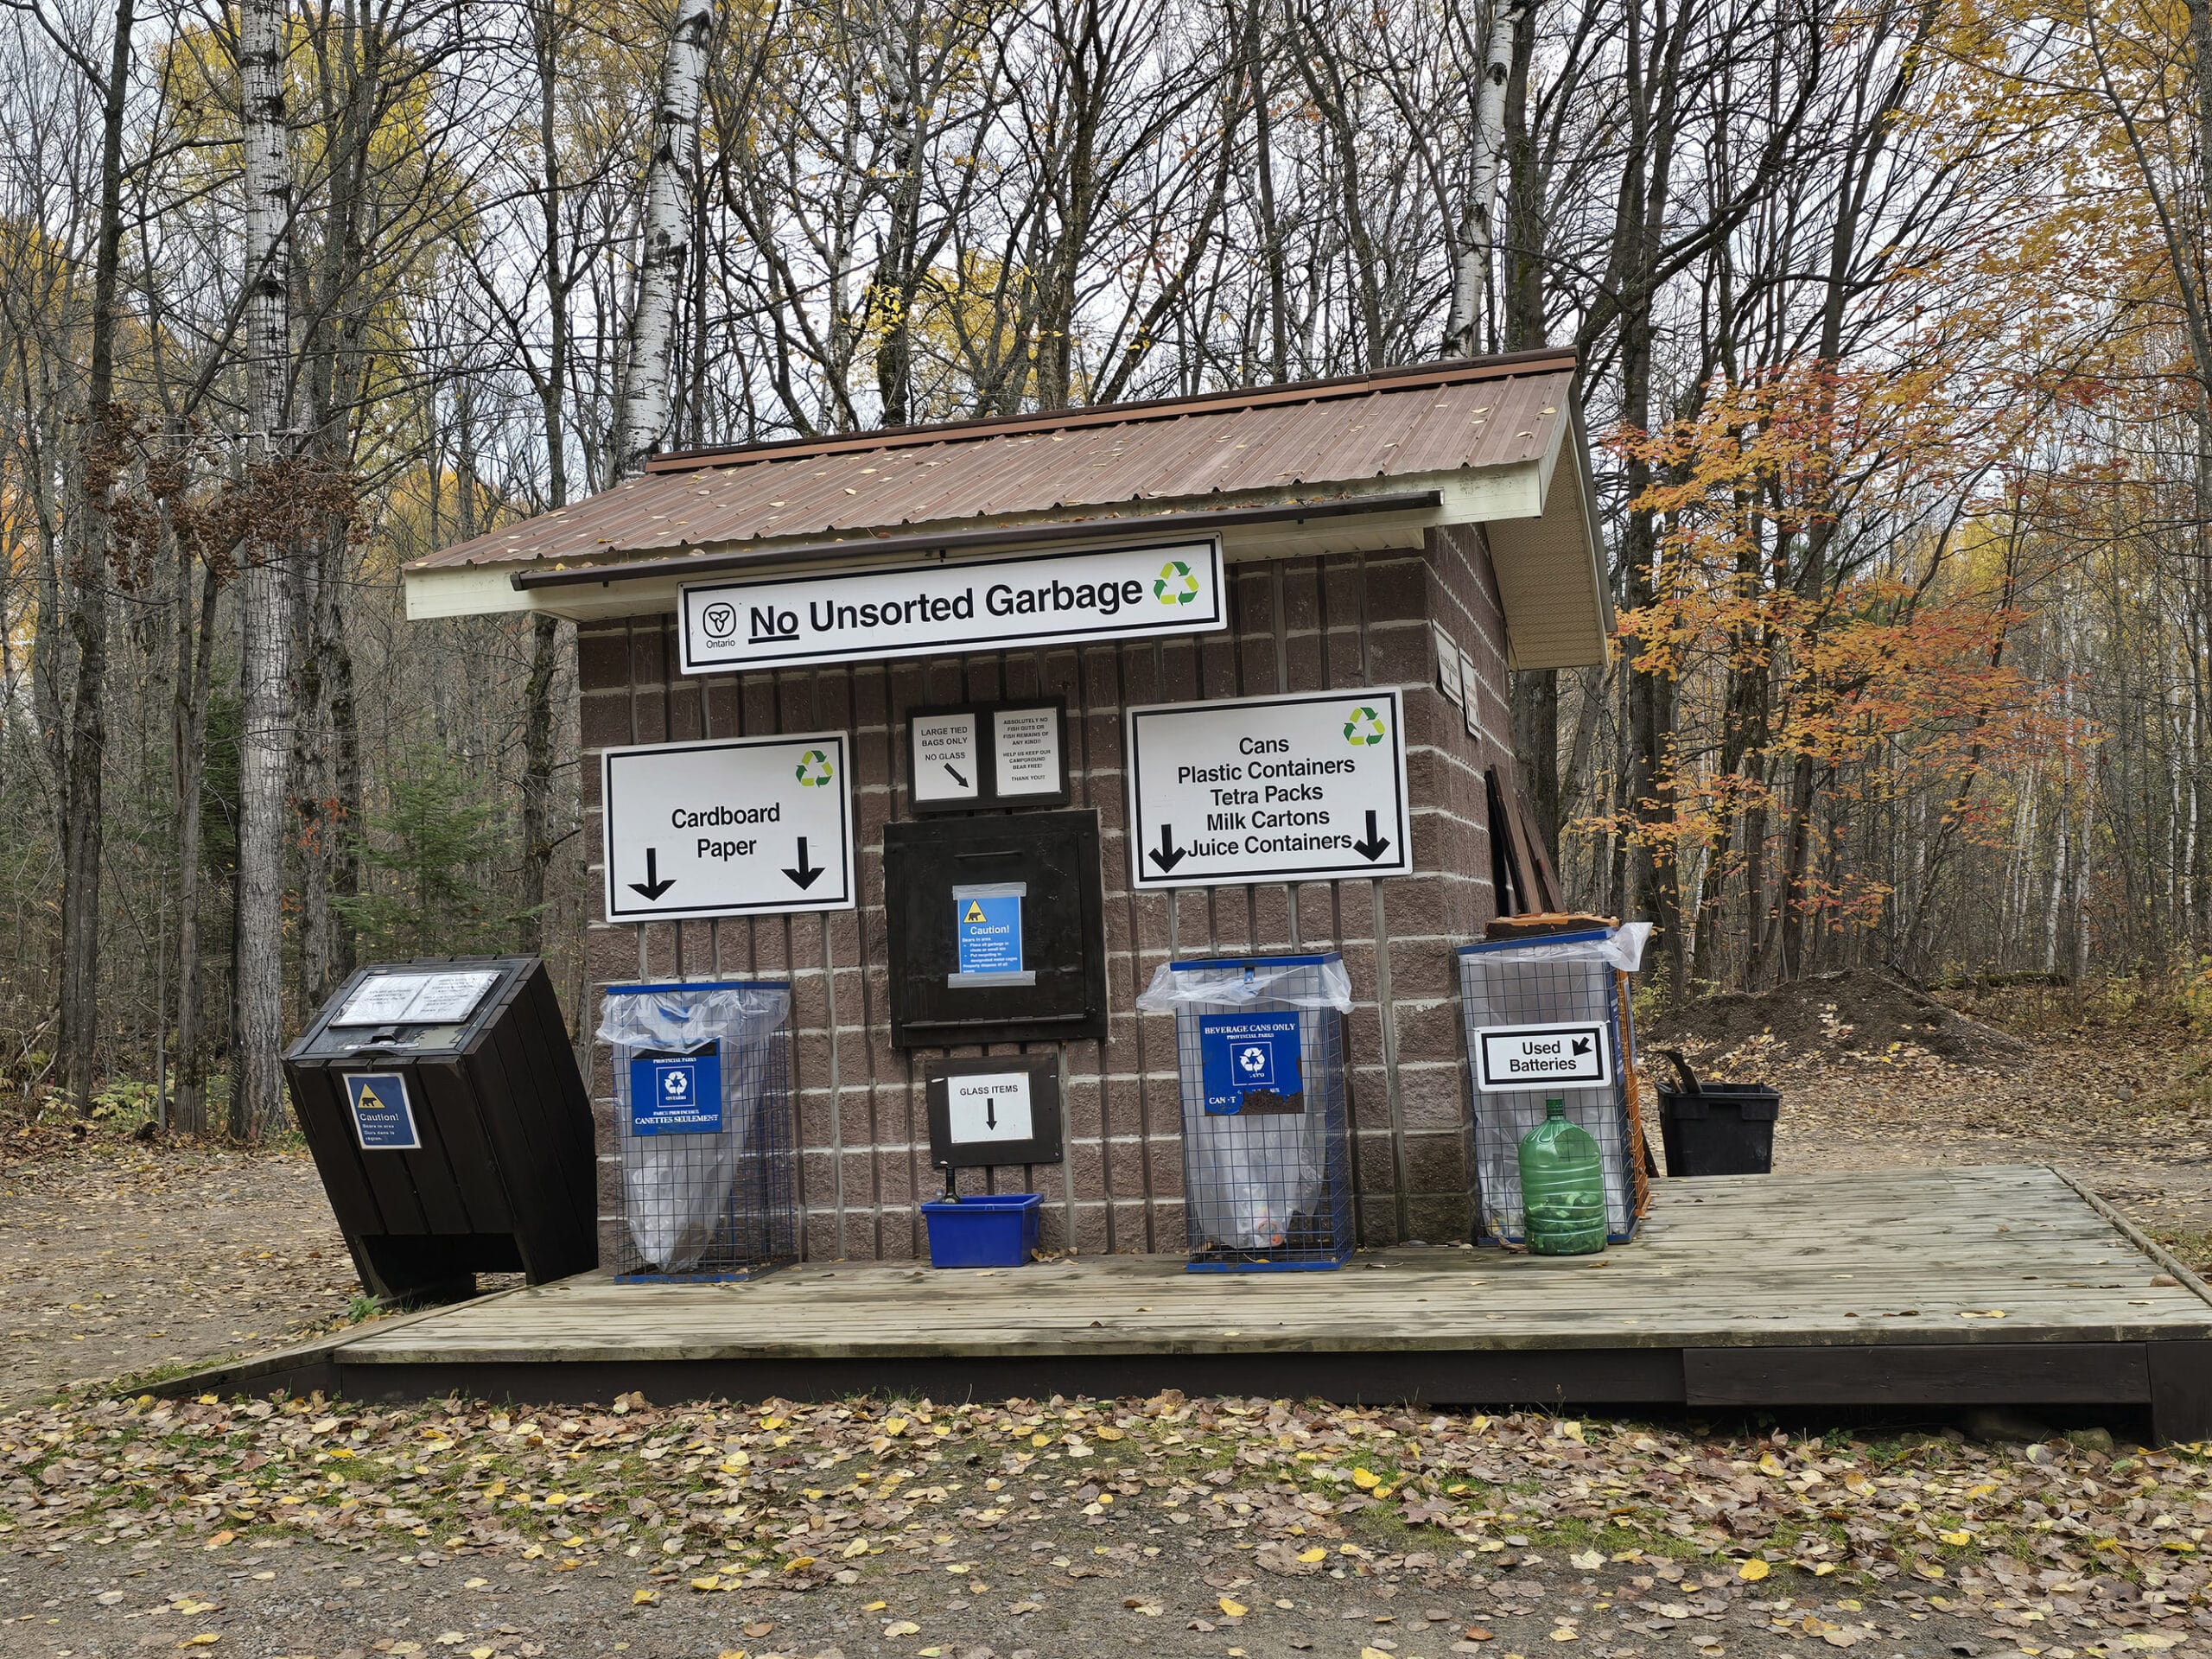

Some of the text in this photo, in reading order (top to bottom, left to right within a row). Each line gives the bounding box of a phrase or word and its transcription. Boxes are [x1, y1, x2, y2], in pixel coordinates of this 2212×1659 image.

[749, 580, 1142, 637] No Unsorted Garbage
[706, 639, 735, 649] Ontario
[921, 728, 947, 736] LARGE
[1239, 737, 1289, 755] Cans
[1178, 759, 1355, 784] Plastic Containers
[1210, 784, 1324, 806] Tetra Packs
[672, 802, 779, 828] Cardboard
[1207, 810, 1331, 831] Milk Cartons
[697, 838, 757, 862] Paper
[1187, 834, 1353, 858] Juice Containers
[970, 925, 1009, 935] Caution!
[1205, 1026, 1249, 1034] BEVERAGE
[1522, 1040, 1560, 1055] Used
[1510, 1058, 1577, 1072] Batteries
[960, 1085, 1018, 1096] GLASS ITEMS
